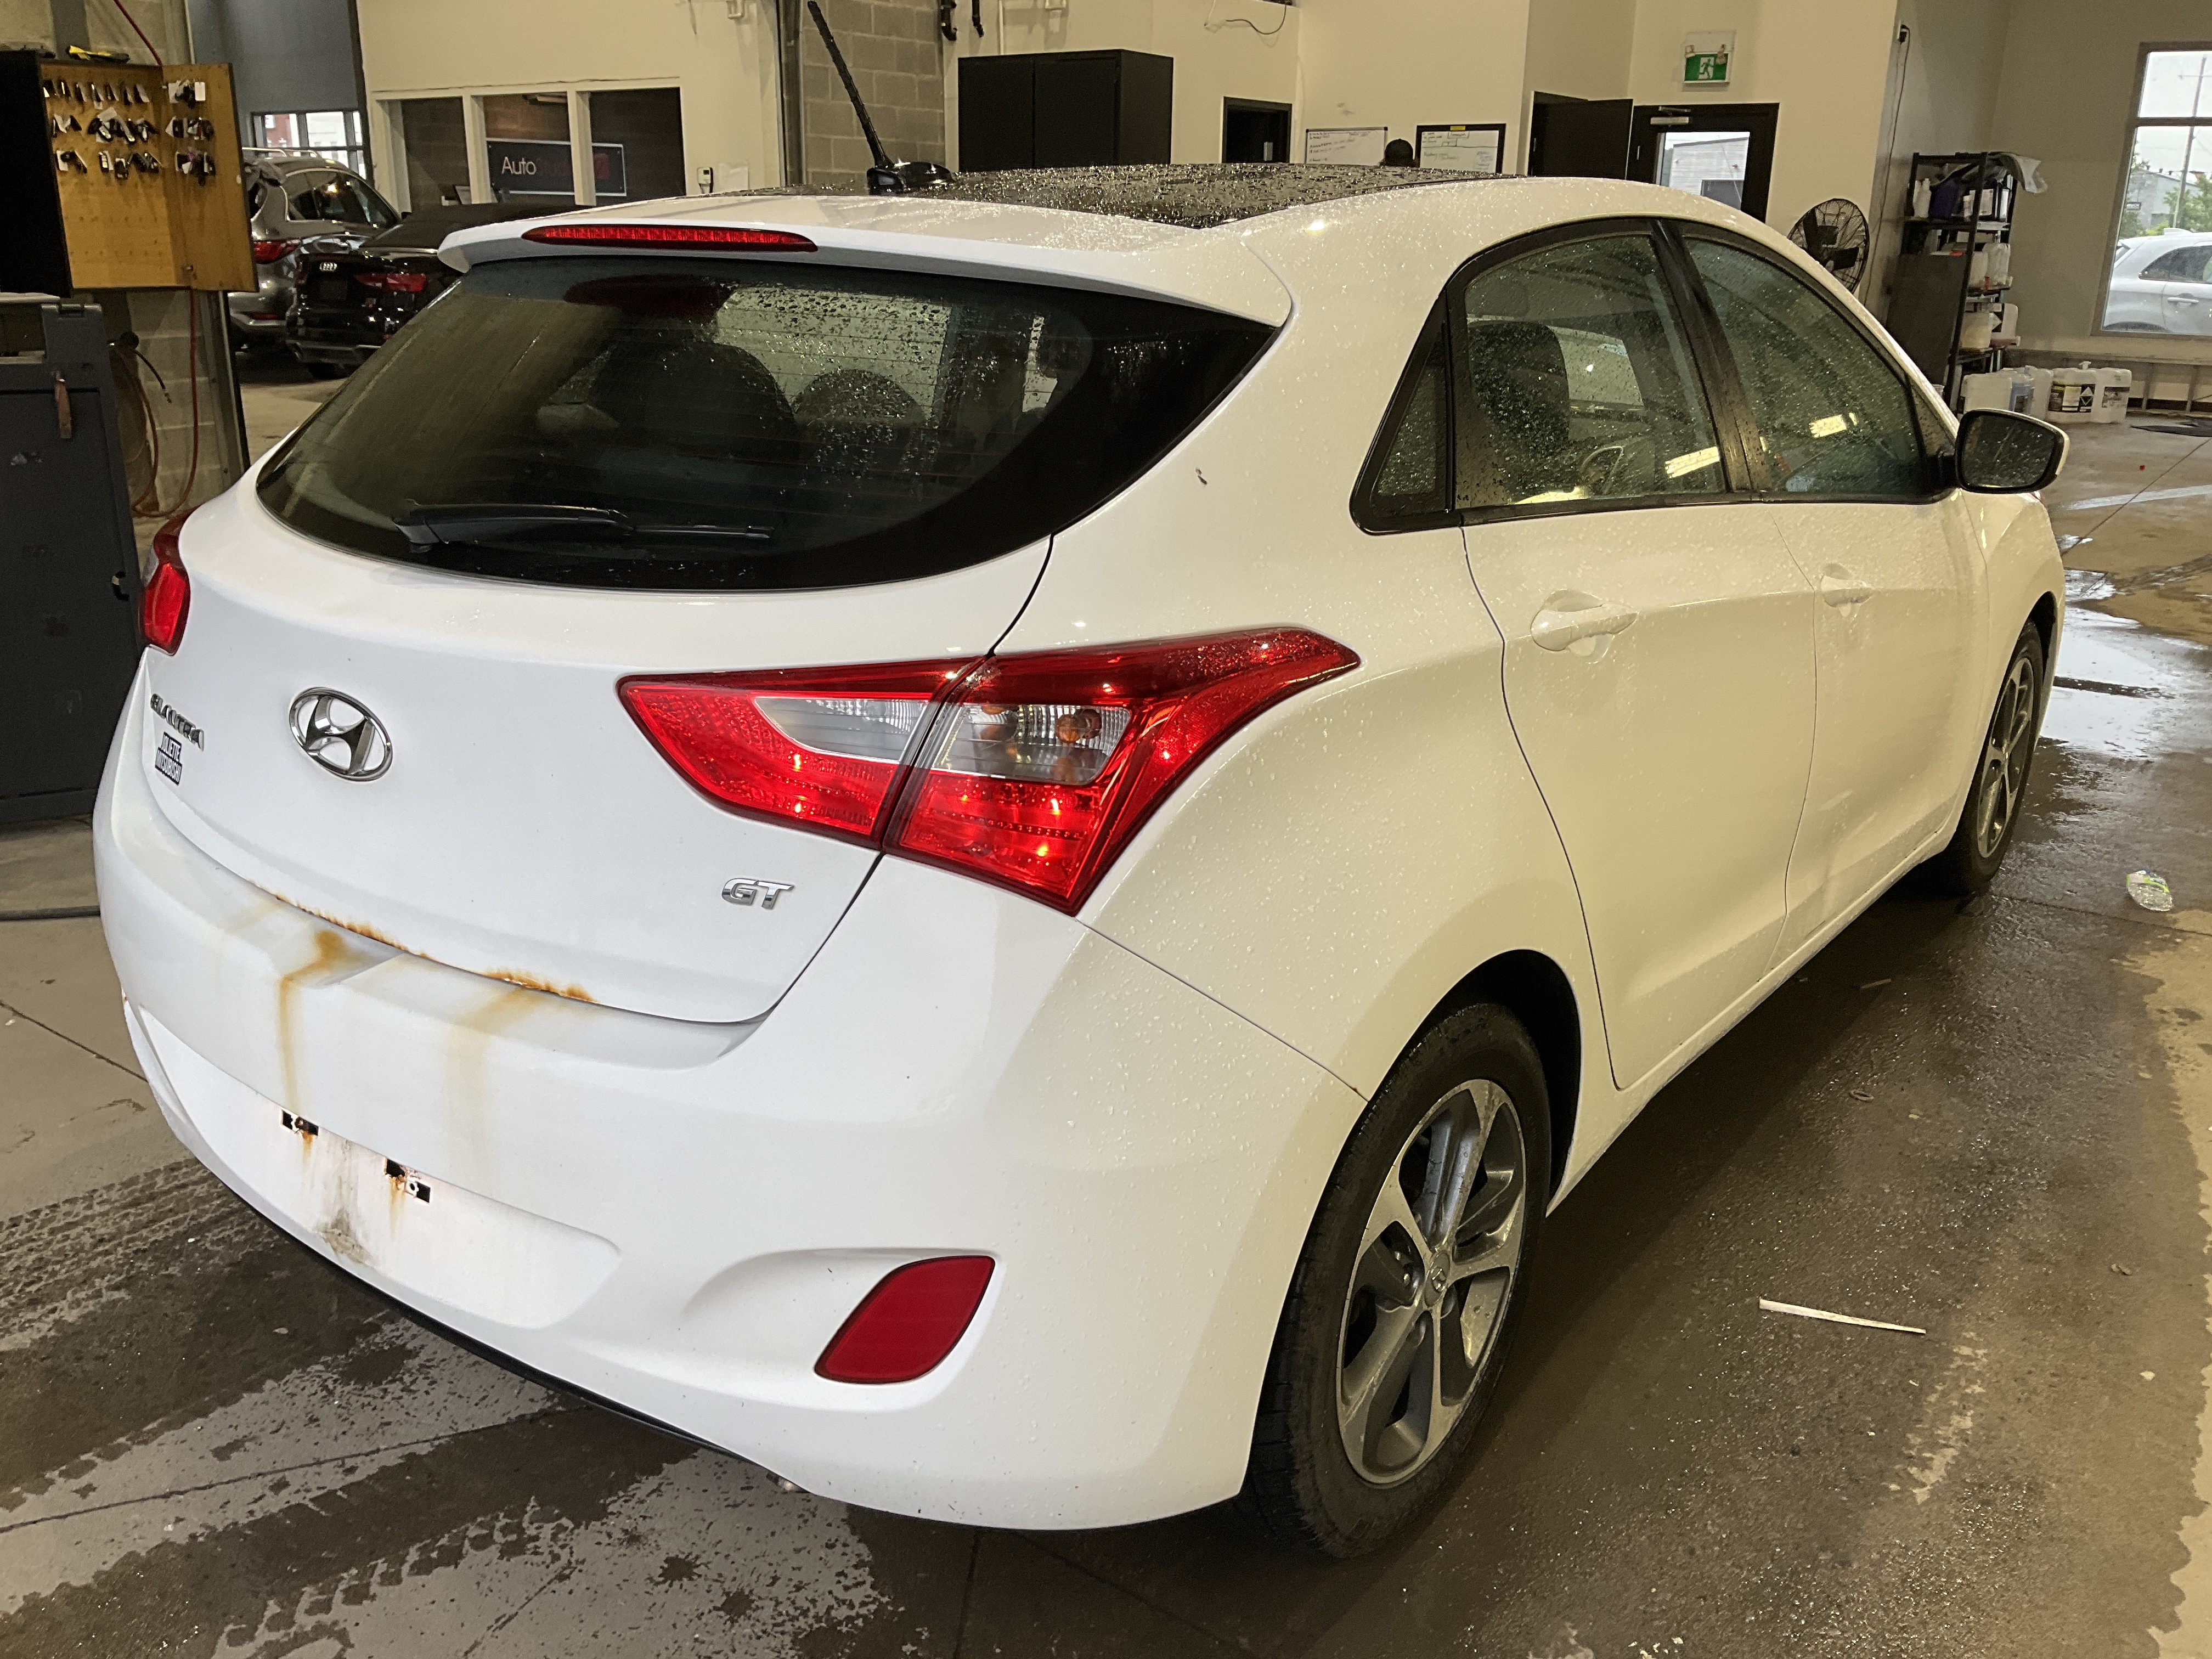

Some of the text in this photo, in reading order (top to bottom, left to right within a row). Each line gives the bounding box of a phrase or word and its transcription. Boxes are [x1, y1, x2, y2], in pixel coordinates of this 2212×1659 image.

[501, 156, 537, 176] Auto
[155, 749, 182, 783] MITSUBISHI
[721, 878, 794, 910] GT
